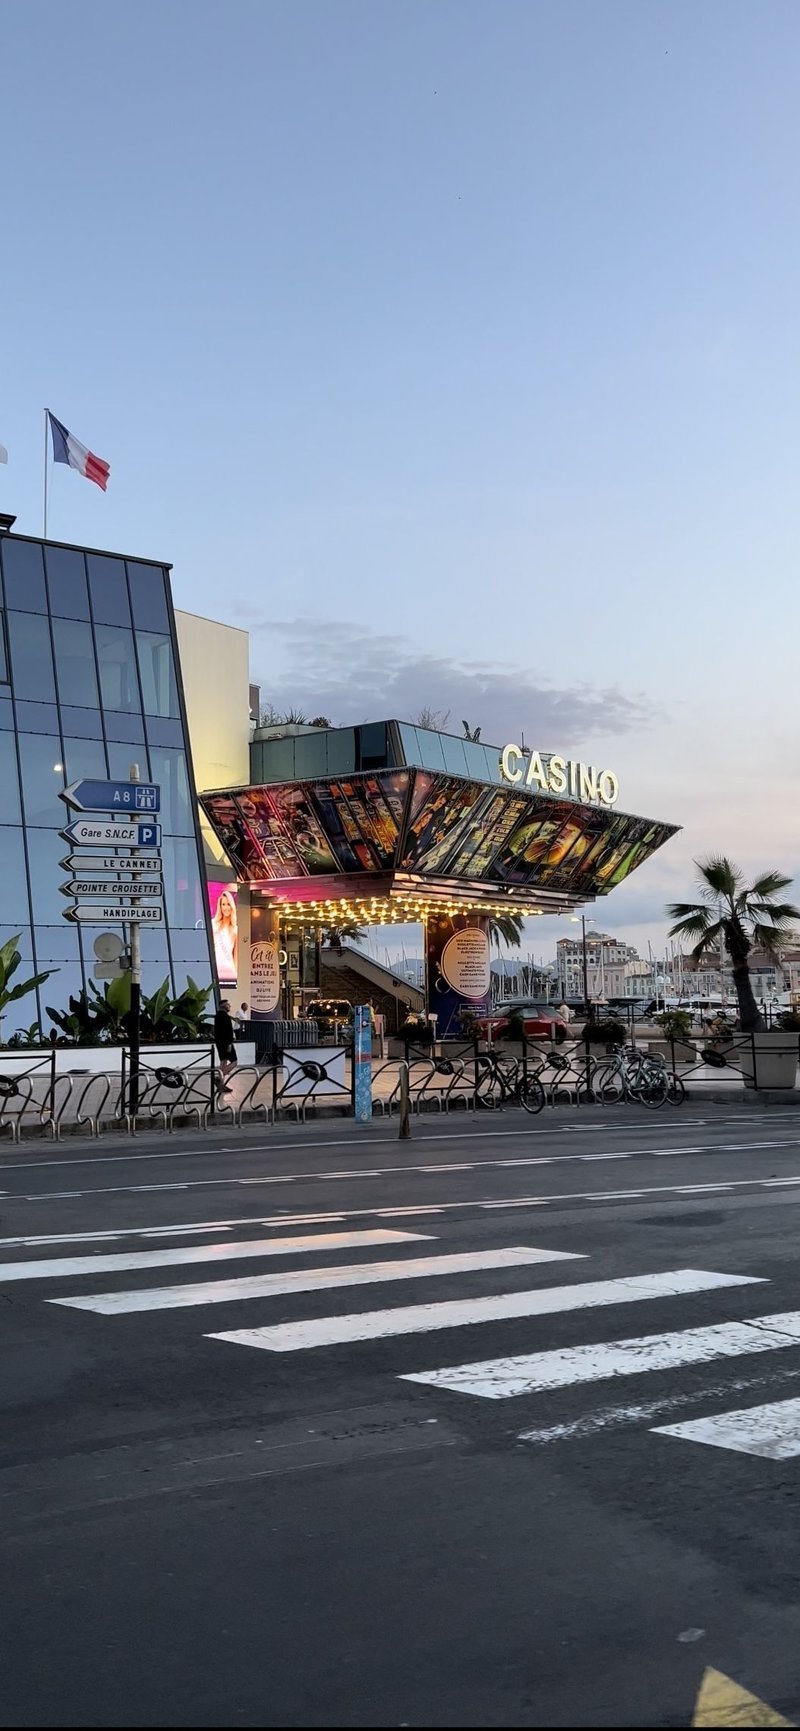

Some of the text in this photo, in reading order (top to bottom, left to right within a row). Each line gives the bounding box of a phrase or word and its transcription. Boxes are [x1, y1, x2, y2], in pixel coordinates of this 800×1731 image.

[501, 743, 619, 804] CASINO
[80, 828, 102, 838] Gare
[142, 828, 153, 842] P
[103, 859, 158, 869] LE CANNET
[76, 884, 158, 893] POINTE CROISETTE
[103, 909, 158, 918] HANDIPLAGE
